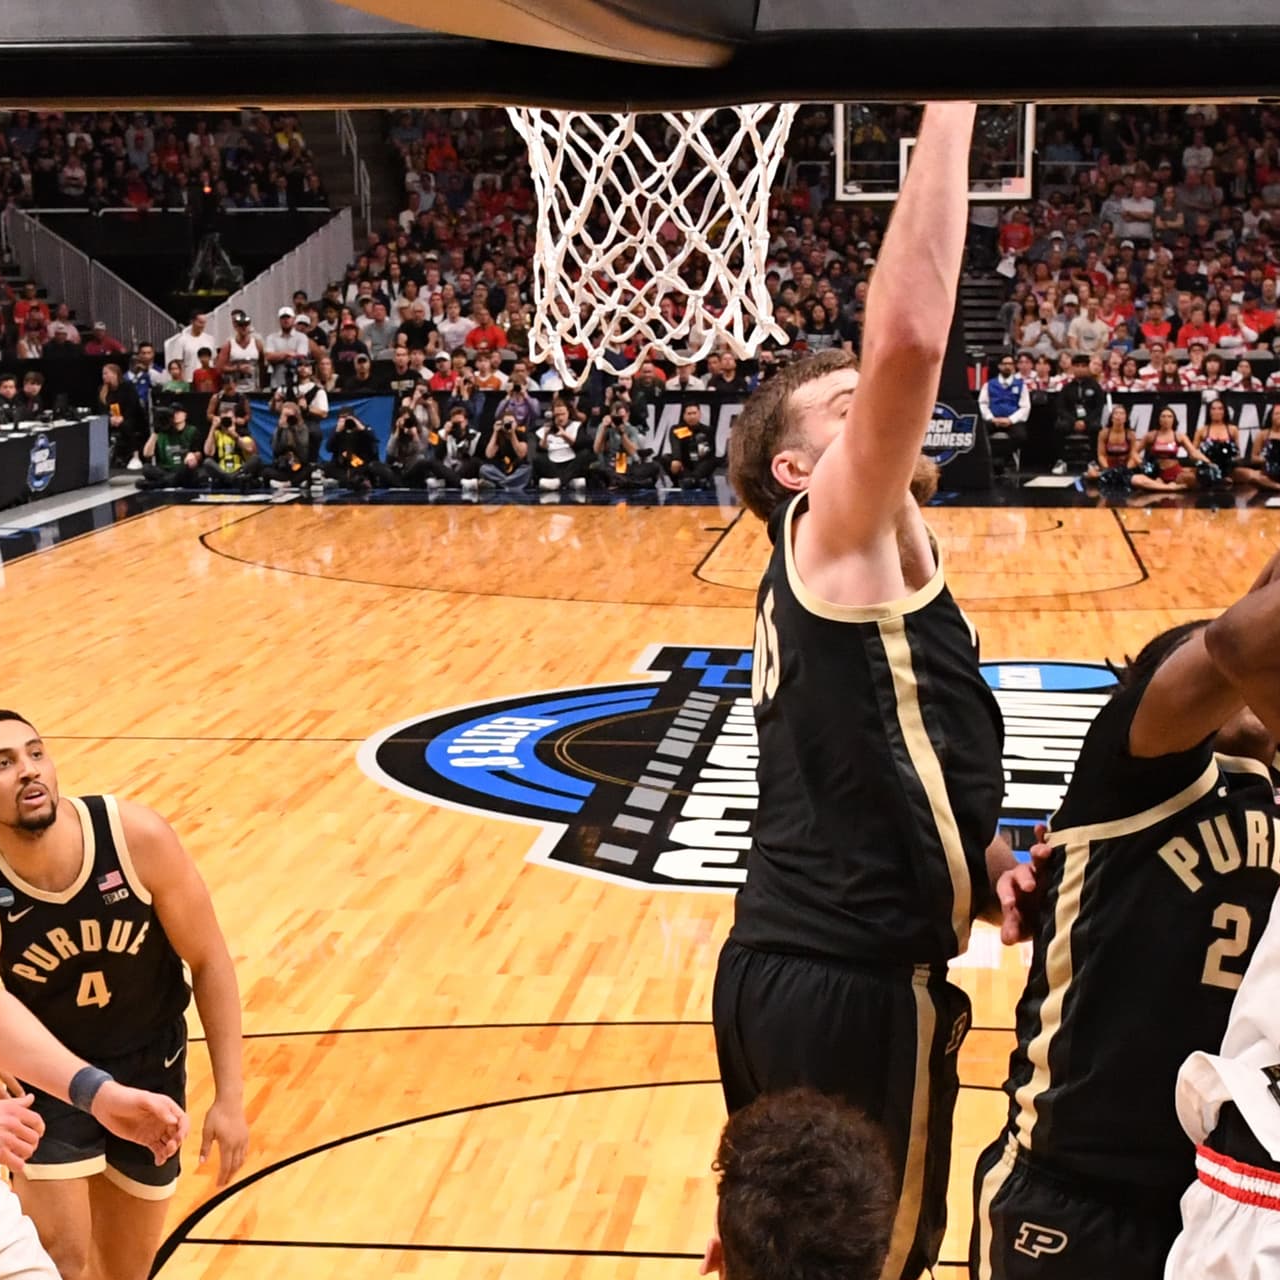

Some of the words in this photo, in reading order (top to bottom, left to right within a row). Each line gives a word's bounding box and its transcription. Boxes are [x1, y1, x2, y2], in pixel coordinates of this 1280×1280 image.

[924, 432, 973, 447] ADNESS
[447, 716, 559, 754] ELITE
[76, 970, 112, 1008] 4
[1014, 1222, 1068, 1258] P
